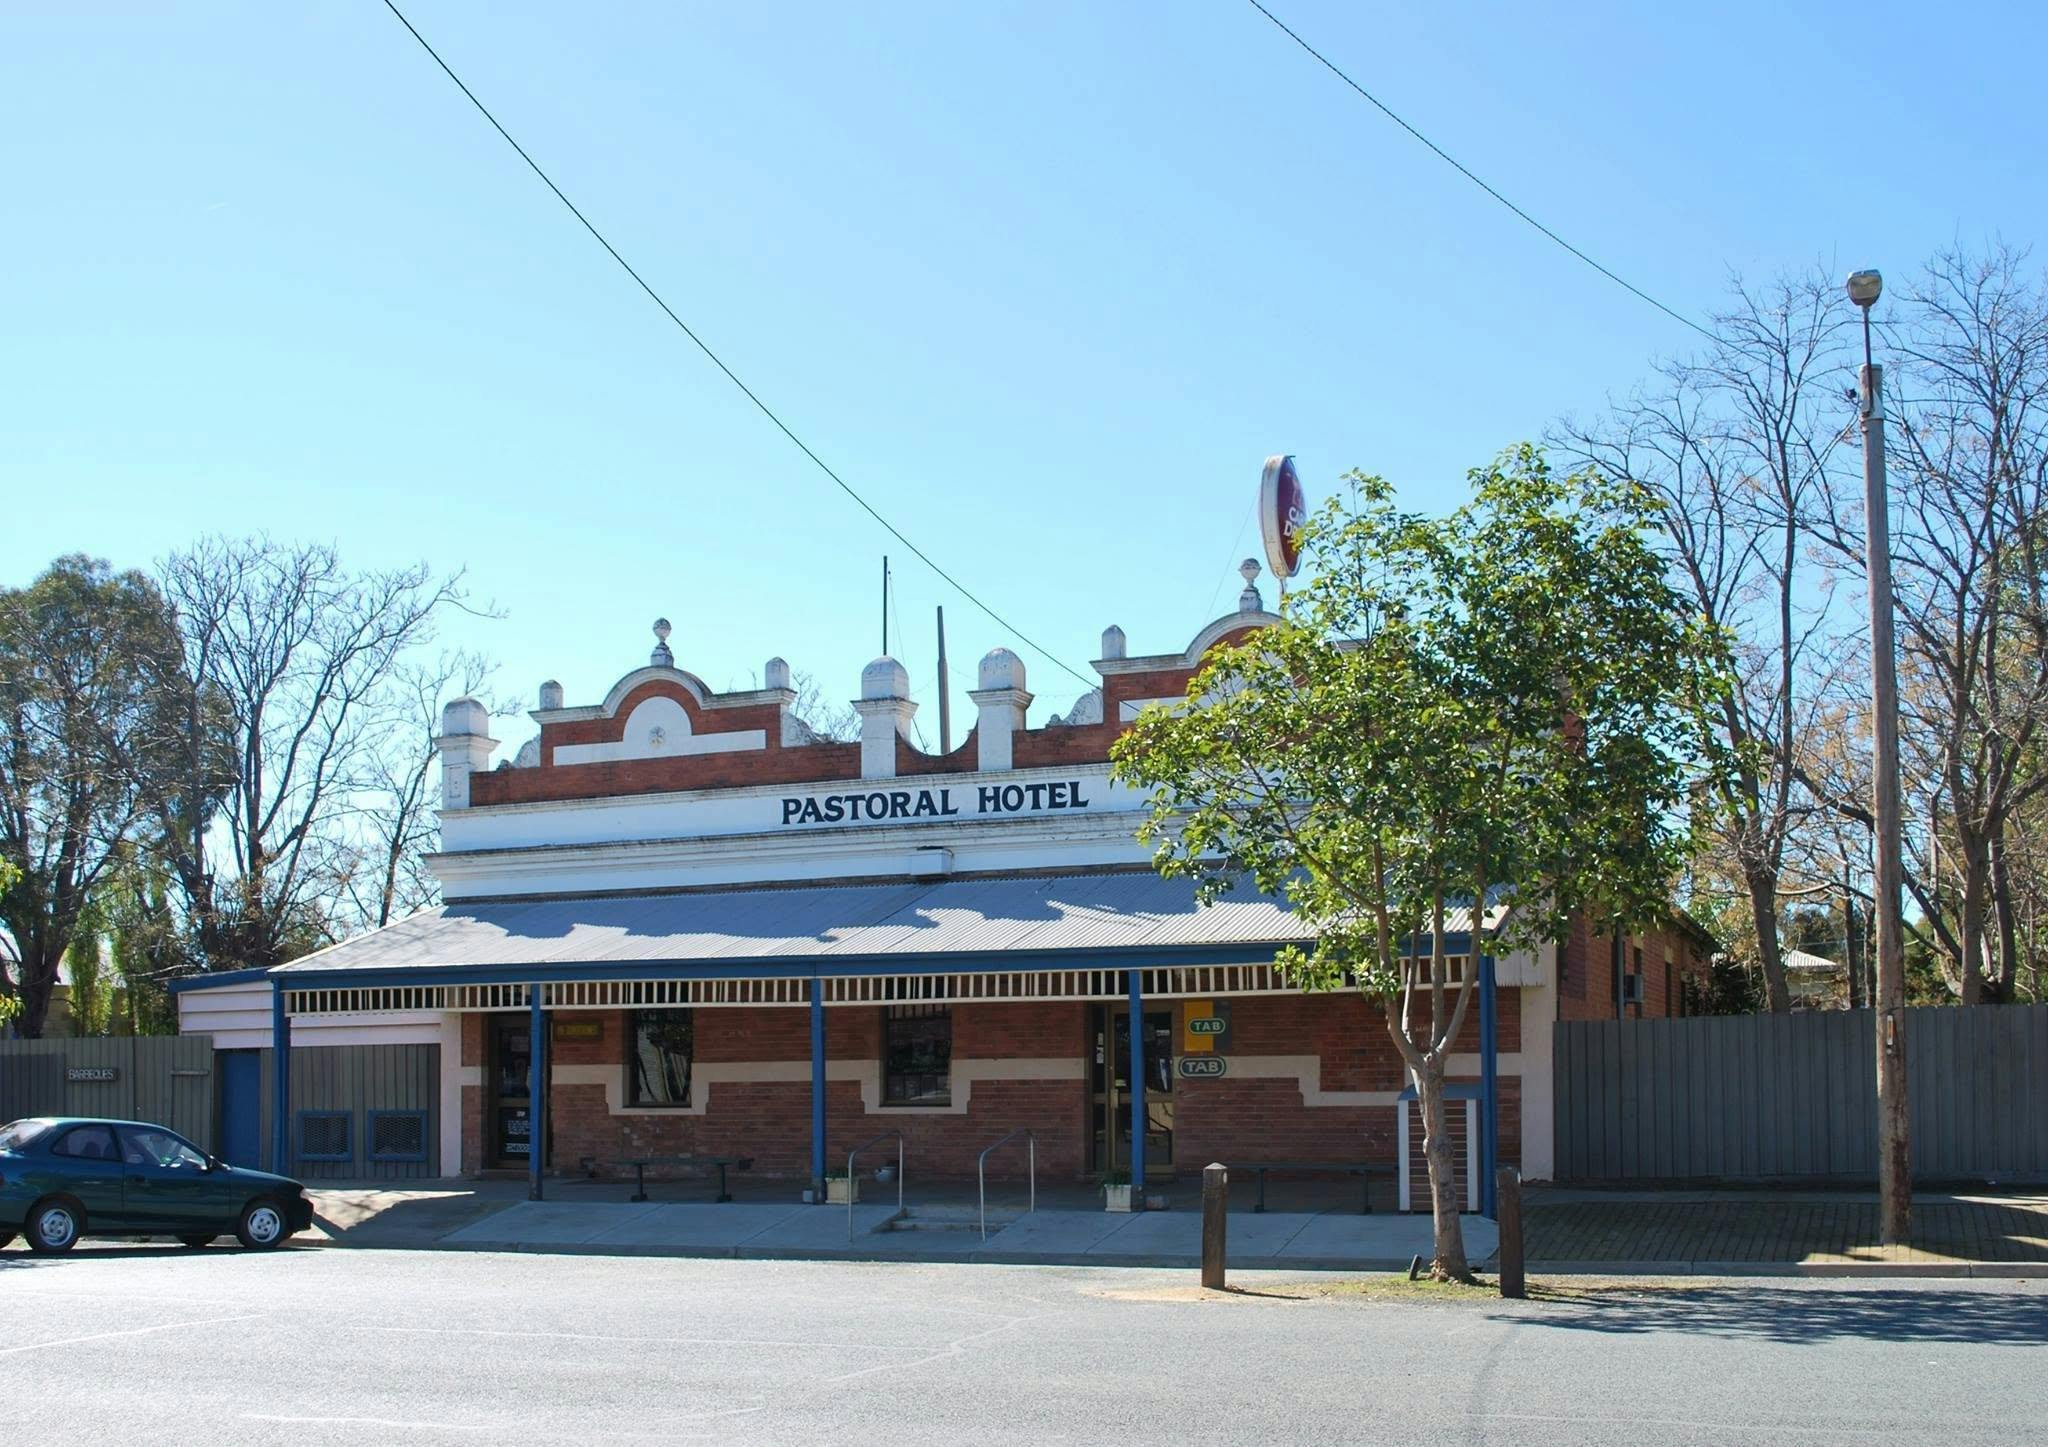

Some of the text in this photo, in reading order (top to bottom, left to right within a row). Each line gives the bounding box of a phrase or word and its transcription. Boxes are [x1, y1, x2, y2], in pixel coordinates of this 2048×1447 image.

[782, 781, 1089, 825] PASTORAL HOTEL
[1194, 1021, 1221, 1032] TAB
[1185, 1061, 1219, 1073] TAB
